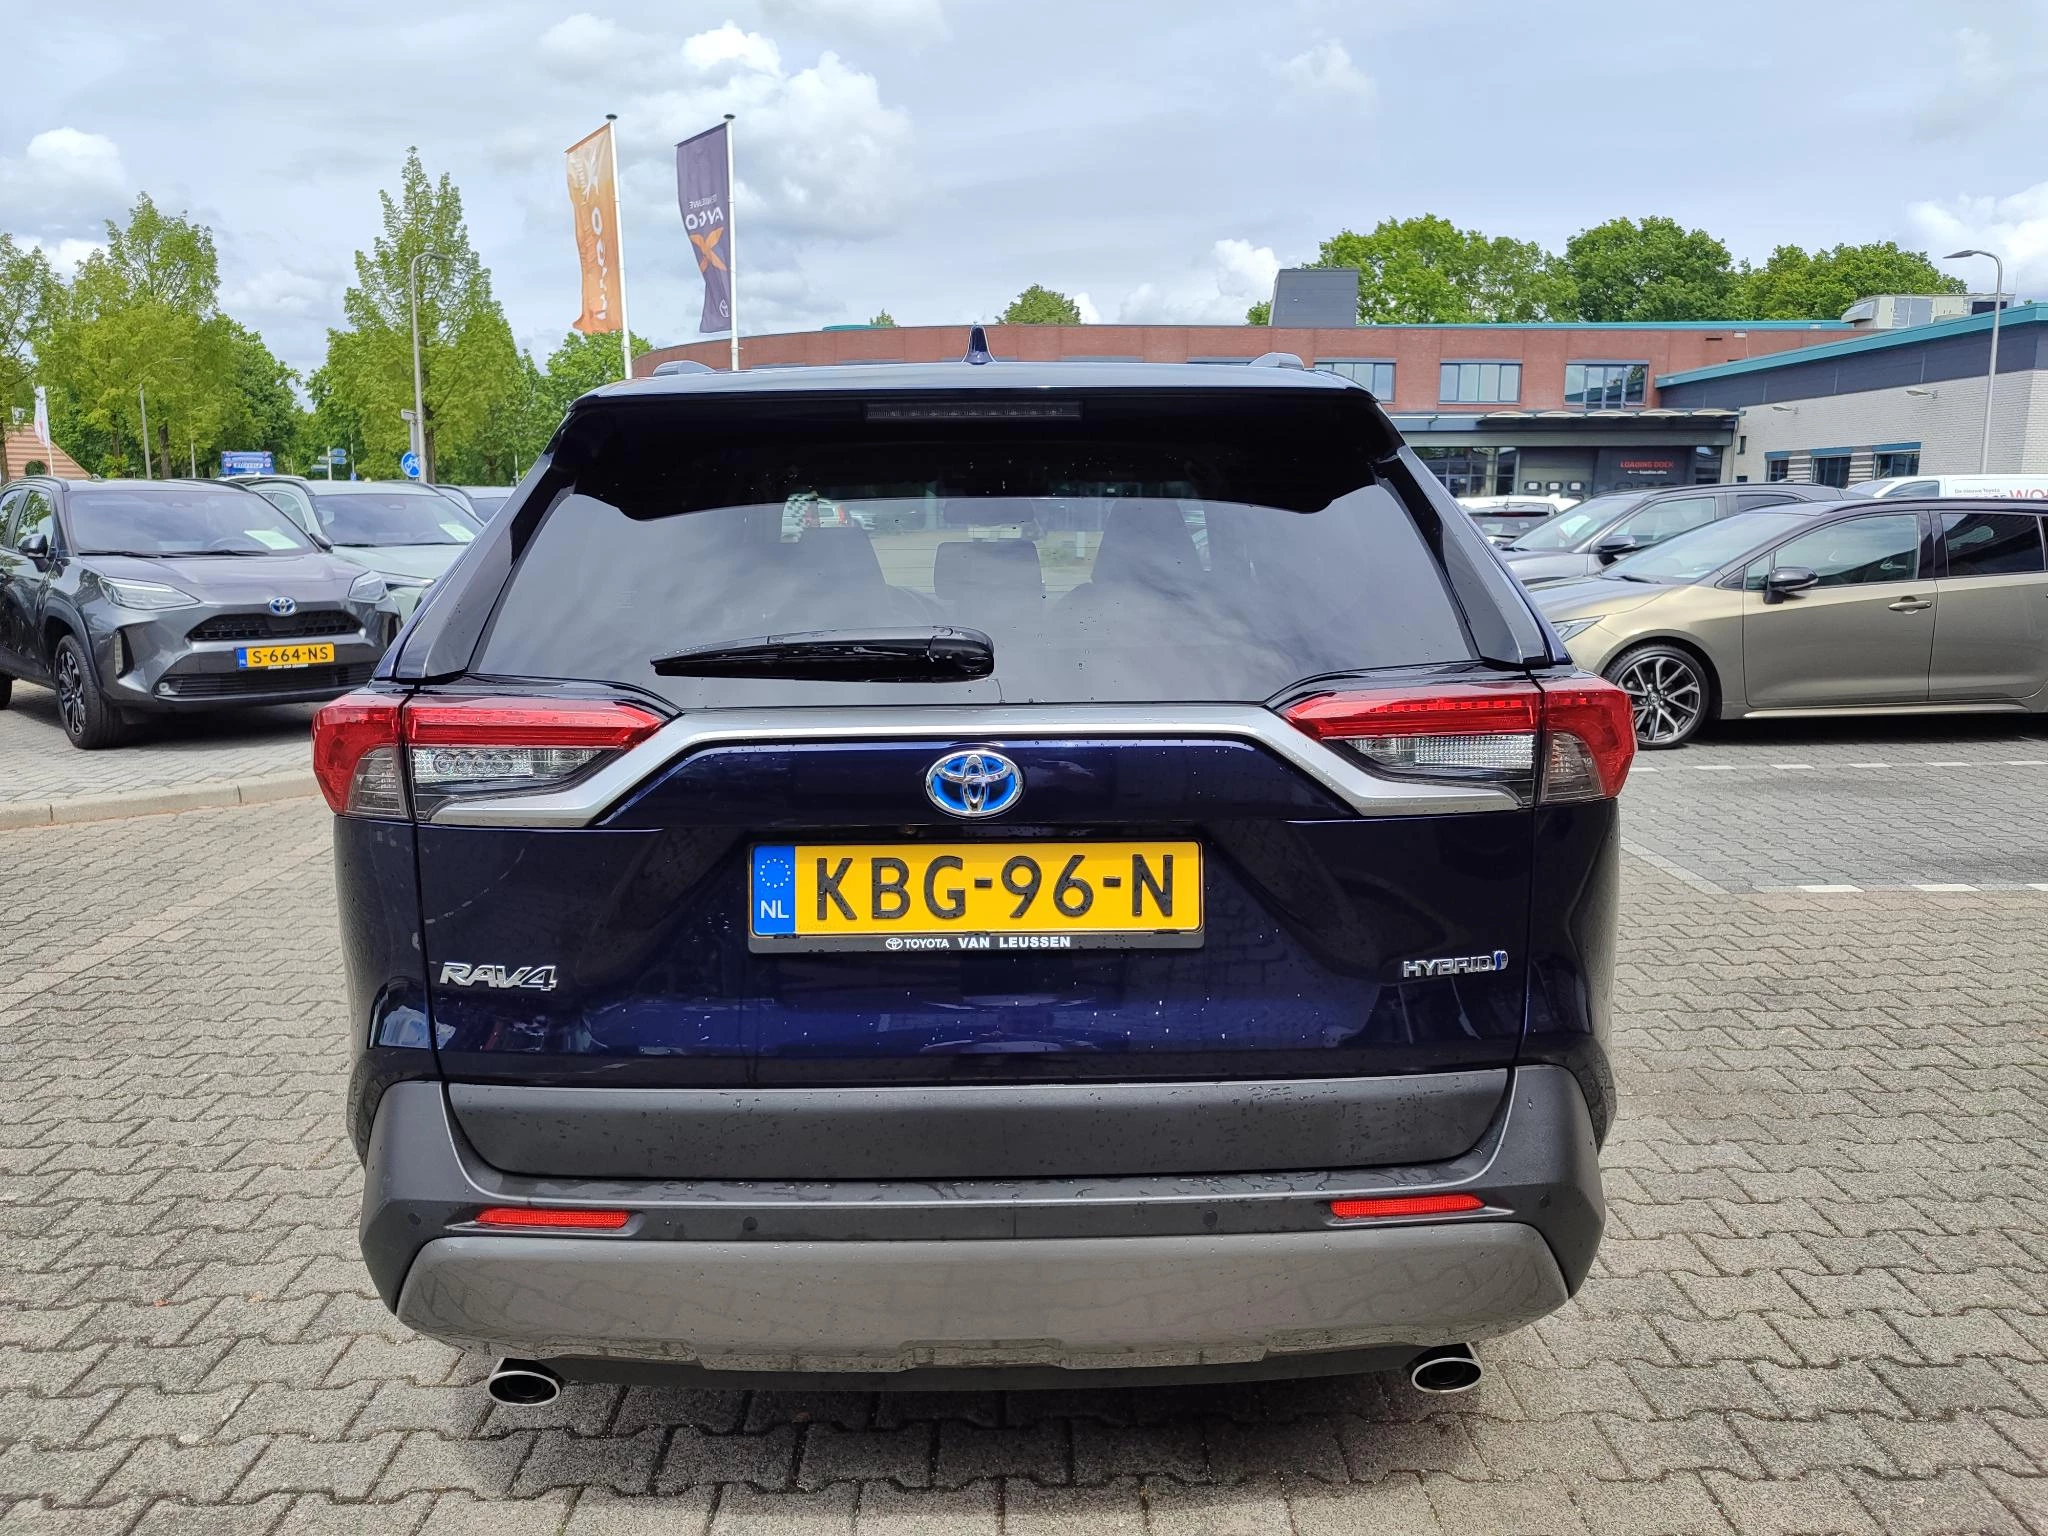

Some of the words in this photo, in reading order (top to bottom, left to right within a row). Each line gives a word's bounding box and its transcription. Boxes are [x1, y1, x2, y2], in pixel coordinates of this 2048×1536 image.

[252, 646, 329, 664] S-664-NS
[816, 854, 1173, 920] KBG-96-N
[760, 900, 790, 919] NL
[904, 938, 950, 949] TOYOTA
[958, 937, 990, 949] VAN
[999, 936, 1071, 949] LEUSSEN
[440, 962, 558, 991] RAV4
[1403, 955, 1492, 978] HYBRID
